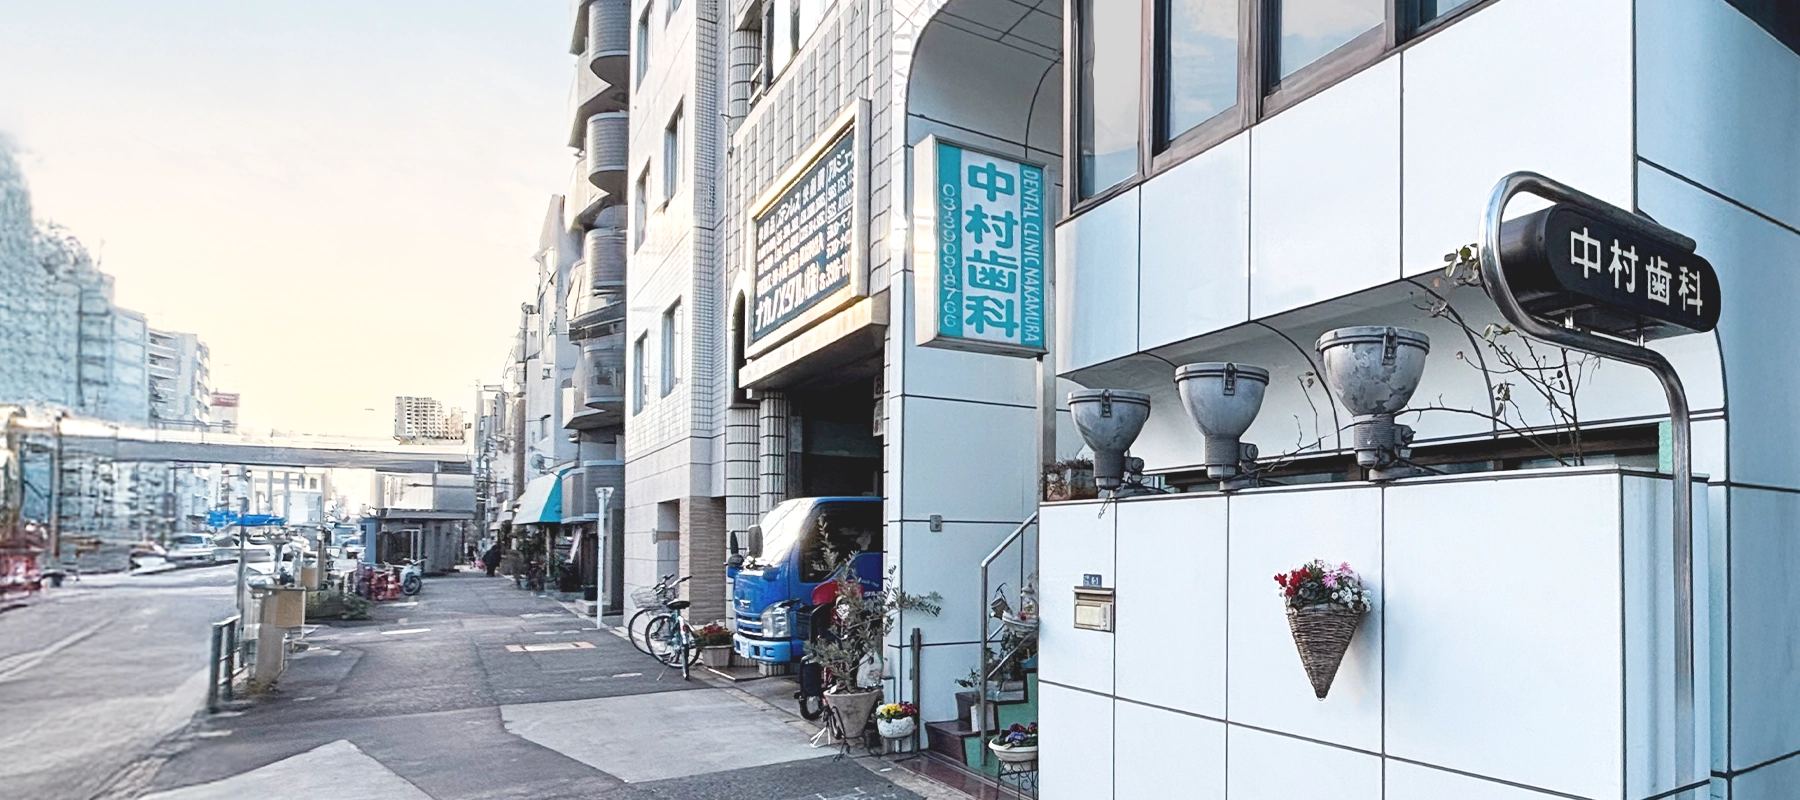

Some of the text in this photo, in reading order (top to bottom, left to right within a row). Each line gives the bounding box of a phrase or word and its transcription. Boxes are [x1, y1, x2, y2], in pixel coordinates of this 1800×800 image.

[965, 162, 1019, 338] 中村歯科
[1023, 168, 1040, 342] DENTAL CLINIC NAKAMURA
[1570, 227, 1703, 316] 中村歯科
